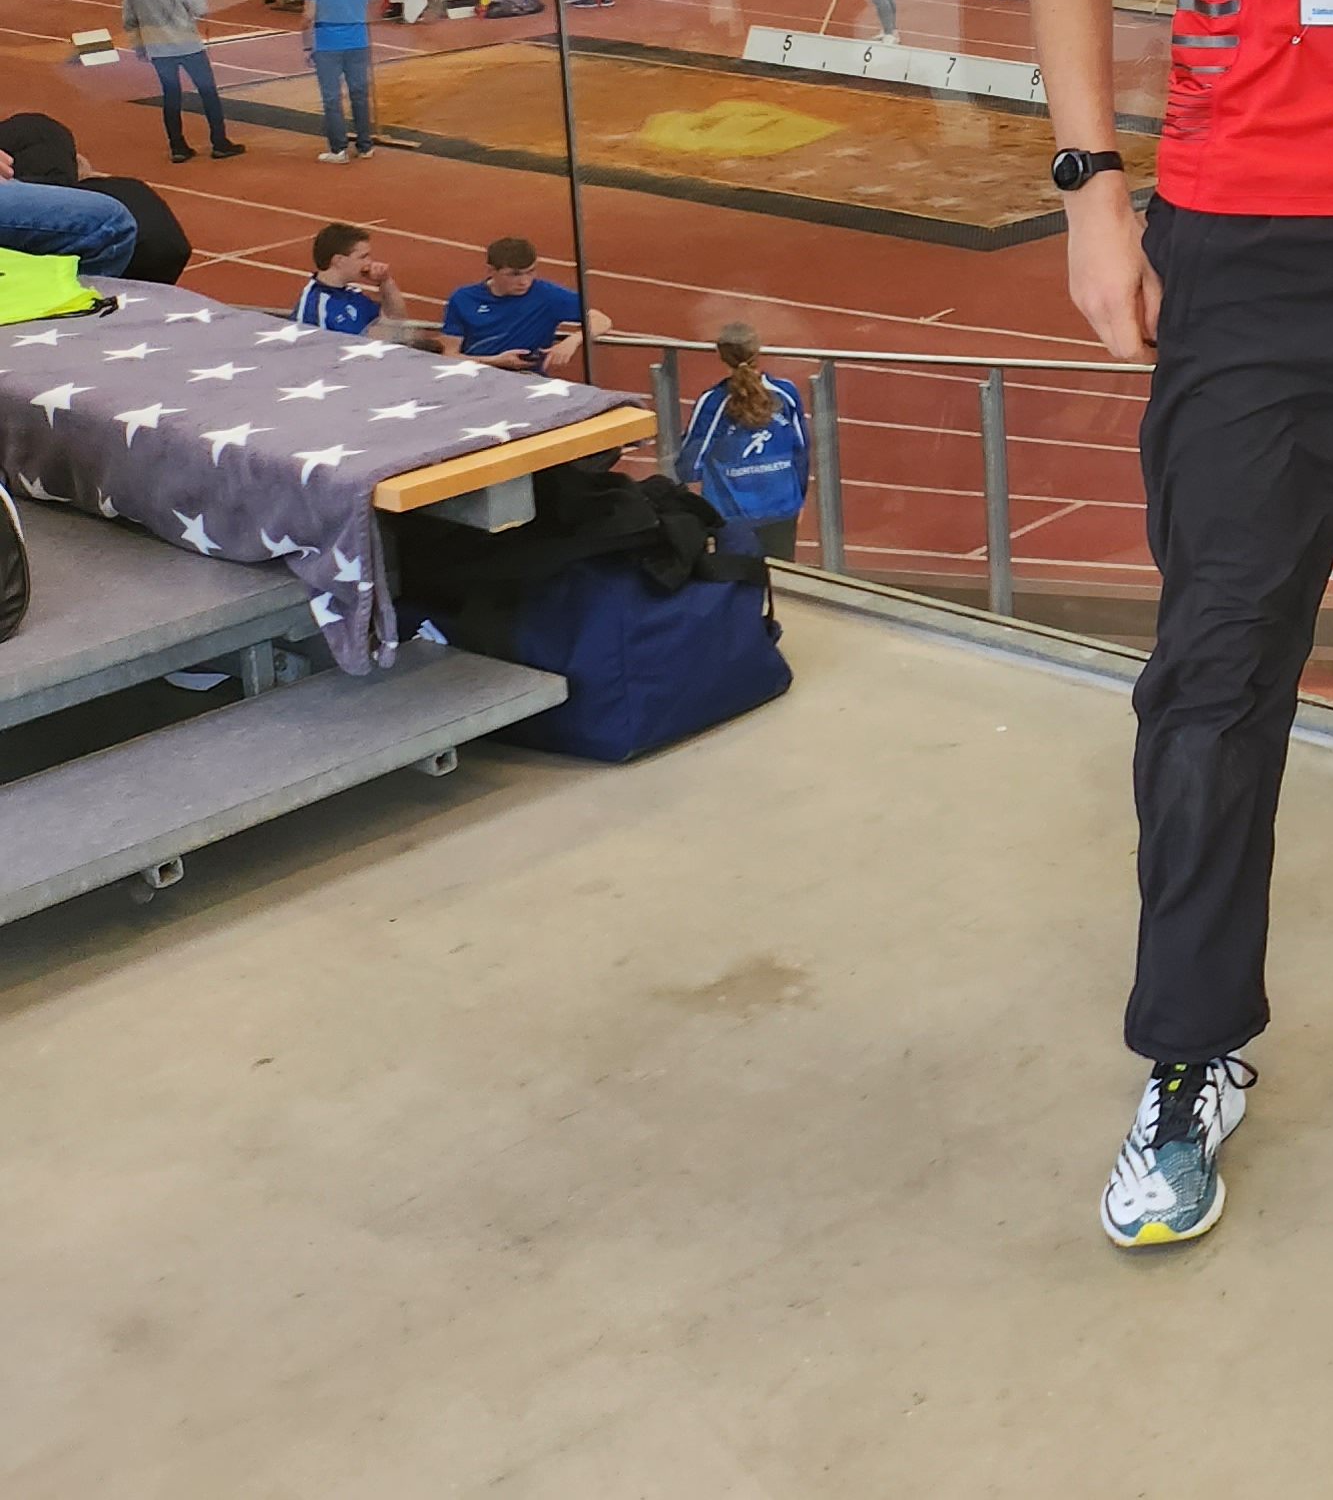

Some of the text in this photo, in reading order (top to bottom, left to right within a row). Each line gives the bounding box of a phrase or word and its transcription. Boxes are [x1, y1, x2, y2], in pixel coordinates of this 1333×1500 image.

[782, 35, 1041, 86] 5 6 7 8
